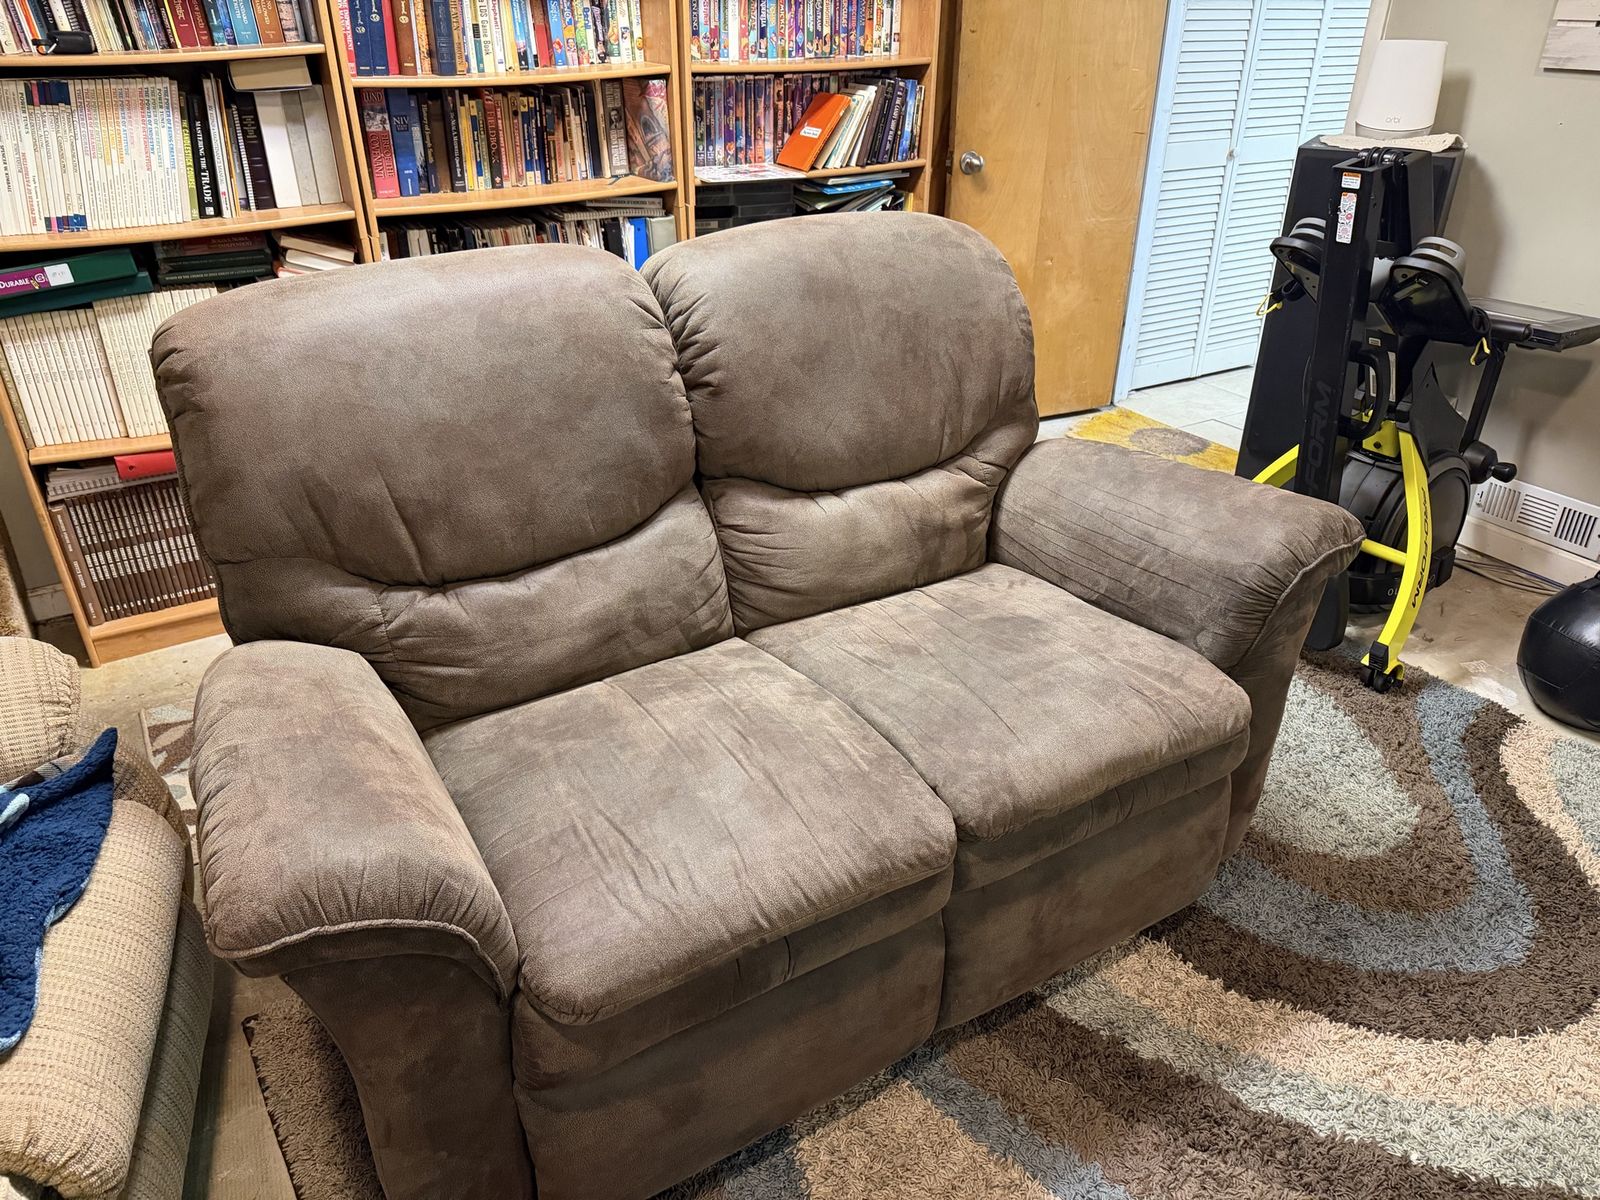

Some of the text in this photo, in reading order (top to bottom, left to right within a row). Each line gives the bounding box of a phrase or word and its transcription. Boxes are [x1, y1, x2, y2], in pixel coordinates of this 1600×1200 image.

[450, 0, 464, 65] HEAVEN BROWN
[479, 5, 492, 56] LDS Game Book
[19, 92, 27, 114] POWER
[393, 117, 409, 125] NIV
[892, 105, 900, 119] CANDY
[85, 100, 93, 120] POWER
[89, 130, 97, 160] DREAMING
[142, 126, 152, 172] DETERMINATION
[182, 129, 193, 166] CANDLESTICK
[487, 111, 499, 163] FIELDBOOK
[0, 145, 12, 193] SPENCER KIMBALL
[57, 136, 67, 174] COMMUNICATION
[68, 135, 78, 174] COMMUNICATION
[195, 121, 213, 203] MASTERING THE TRADE
[370, 132, 385, 179] COVENANT
[381, 133, 395, 177] FIRE OF THE
[1412, 487, 1428, 608] PRO-FORM
